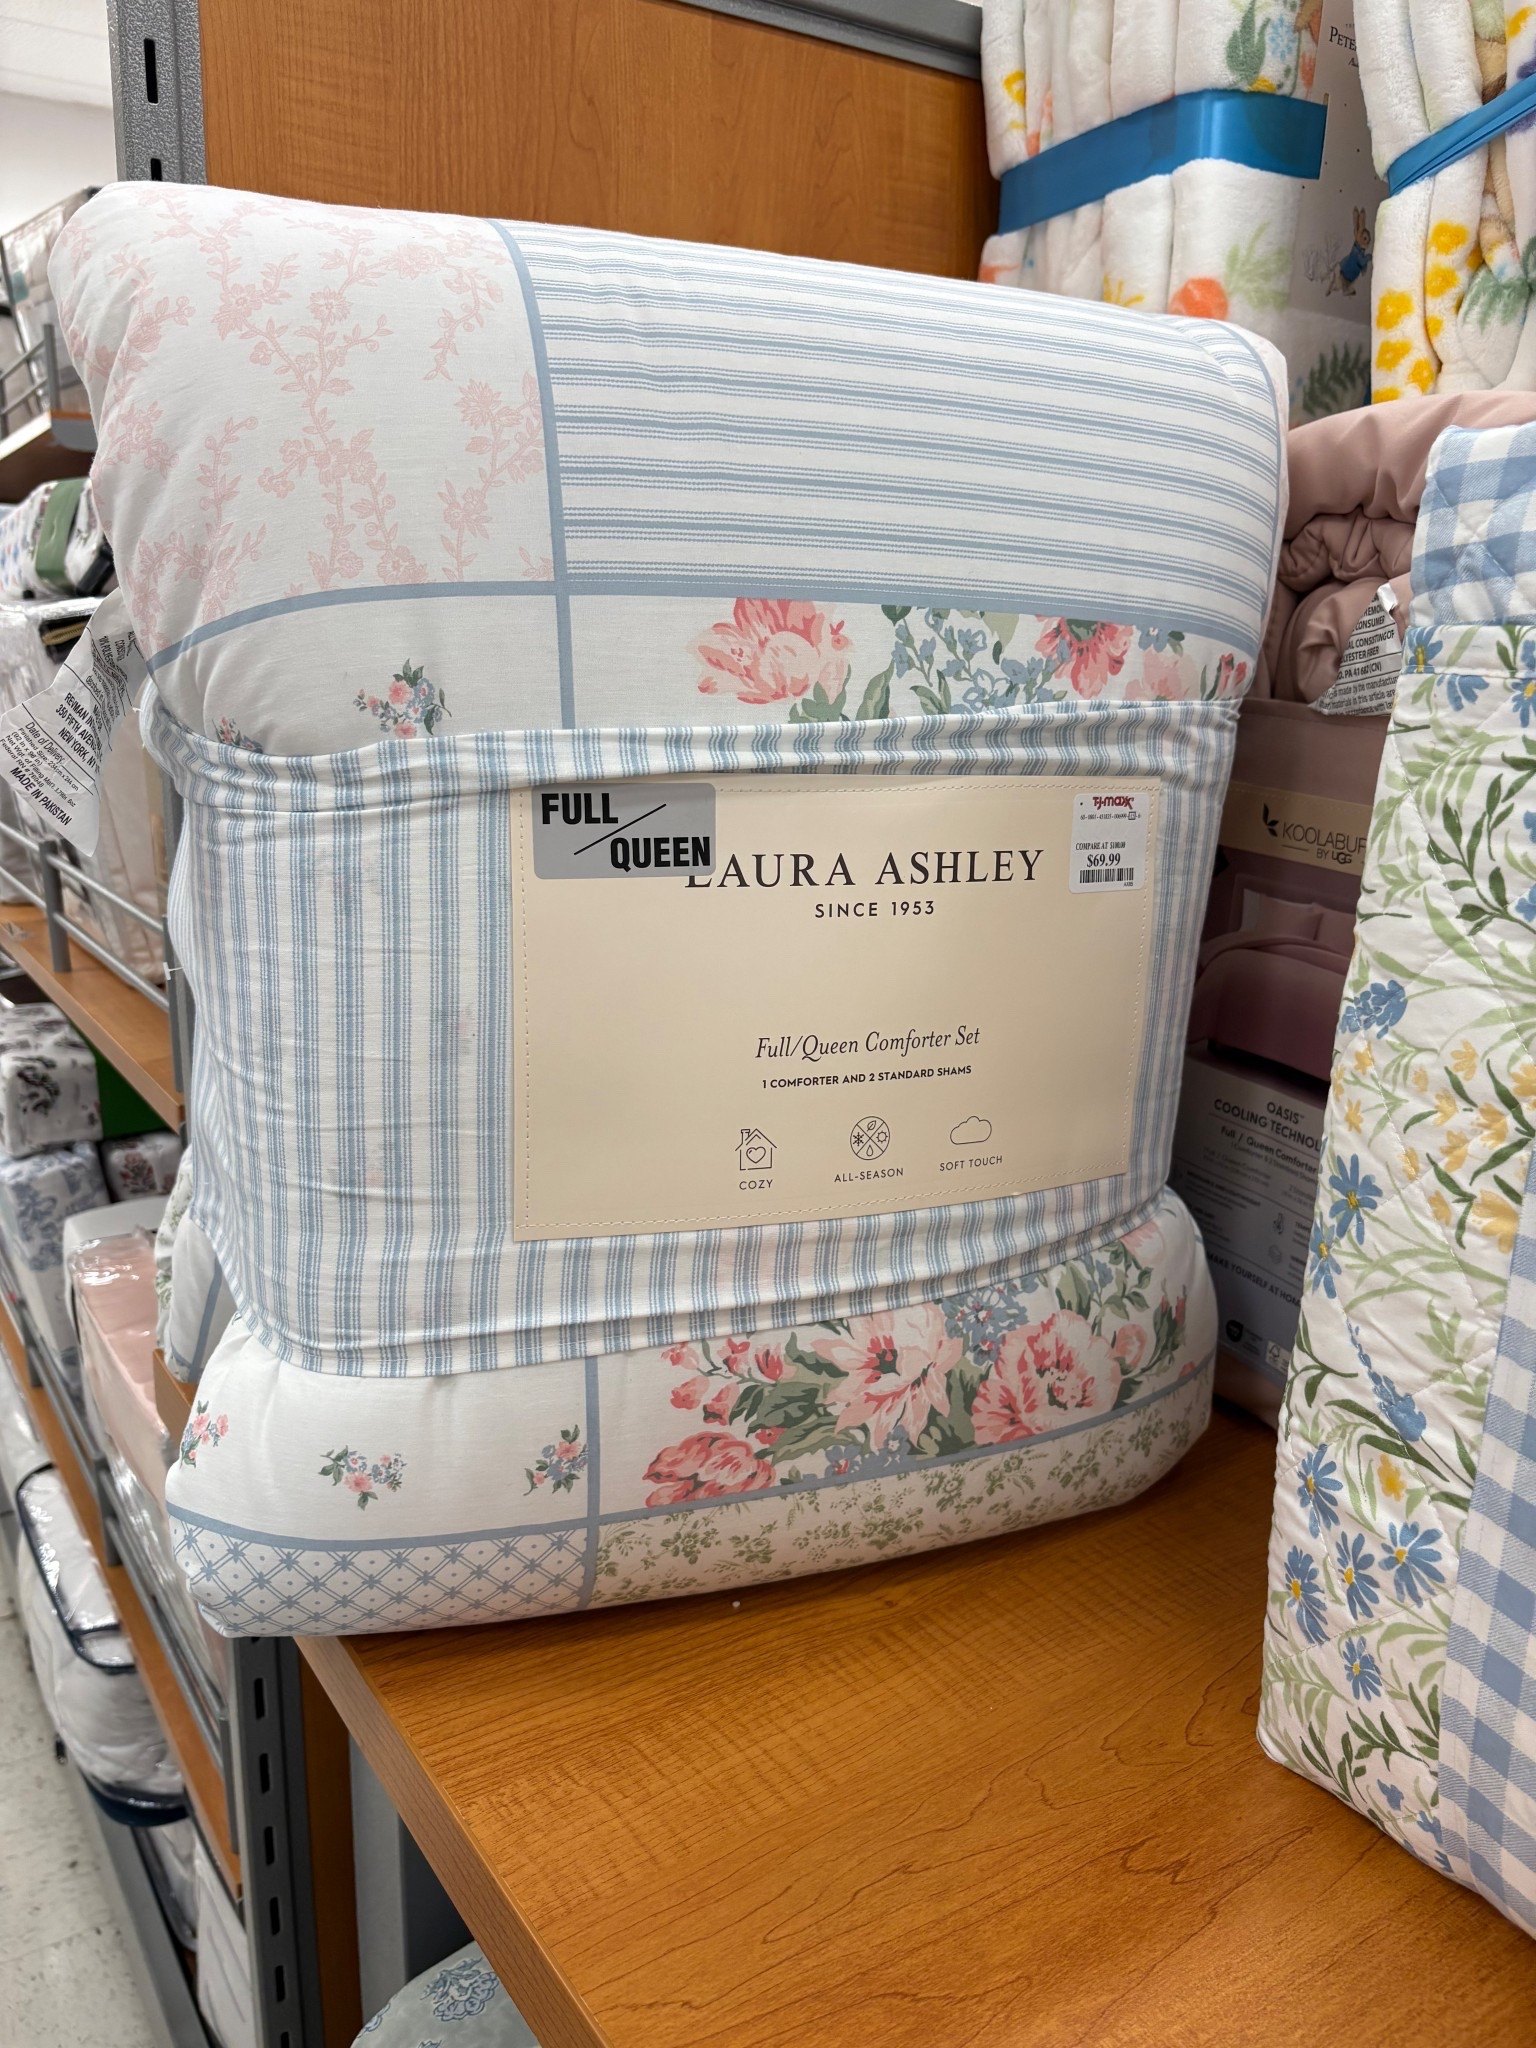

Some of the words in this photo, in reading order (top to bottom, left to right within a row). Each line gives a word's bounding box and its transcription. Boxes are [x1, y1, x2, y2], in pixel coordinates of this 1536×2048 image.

[1329, 25, 1357, 52] PETE
[1342, 650, 1367, 663] LYESTER
[1344, 668, 1353, 679] PA
[1365, 676, 1399, 690] manufactur
[55, 704, 67, 719] 350
[65, 714, 82, 733] FIFTH
[5, 735, 15, 747] Net
[25, 721, 41, 739] Date
[38, 736, 48, 746] of
[58, 727, 73, 745] NEW
[71, 739, 87, 761] YORK,
[10, 766, 36, 791] MADE
[31, 788, 42, 800] IN
[39, 796, 72, 826] PAKISTAN
[541, 793, 619, 825] FULL
[1075, 842, 1100, 851] COMPARE
[1101, 842, 1108, 850] AT
[1282, 821, 1367, 853] KOOLABUR
[610, 836, 711, 873] QUEEN
[1086, 853, 1121, 868] $69.99
[1316, 848, 1329, 860] BY
[1331, 850, 1352, 865] UGG
[874, 849, 1045, 886] ASHLEY
[815, 902, 880, 919] SINCE
[891, 900, 935, 916] 1953
[755, 1034, 859, 1063] Full/Queen
[865, 1028, 952, 1058] Comforter
[954, 1025, 981, 1046] Set
[762, 1079, 768, 1089] 1
[770, 1075, 839, 1089] COMFORTER
[842, 1073, 866, 1084] AND
[869, 1072, 876, 1082] 2
[877, 1068, 935, 1082] STANDARD
[937, 1065, 972, 1077] SHAMS
[1213, 1098, 1268, 1128] COOLING
[1271, 1120, 1321, 1153] TECHNOL
[1221, 1126, 1236, 1139] Full
[1246, 1136, 1275, 1155] Queen
[1275, 1149, 1318, 1175] Comforter
[833, 1167, 905, 1183] ALL-SEASON
[939, 1159, 966, 1172] SOFT
[967, 1155, 1004, 1169] TOUCH
[738, 1179, 774, 1191] COZY
[1231, 1263, 1269, 1289] YOURSELF
[1269, 1283, 1280, 1297] AT
[1279, 1289, 1301, 1307] HOM
